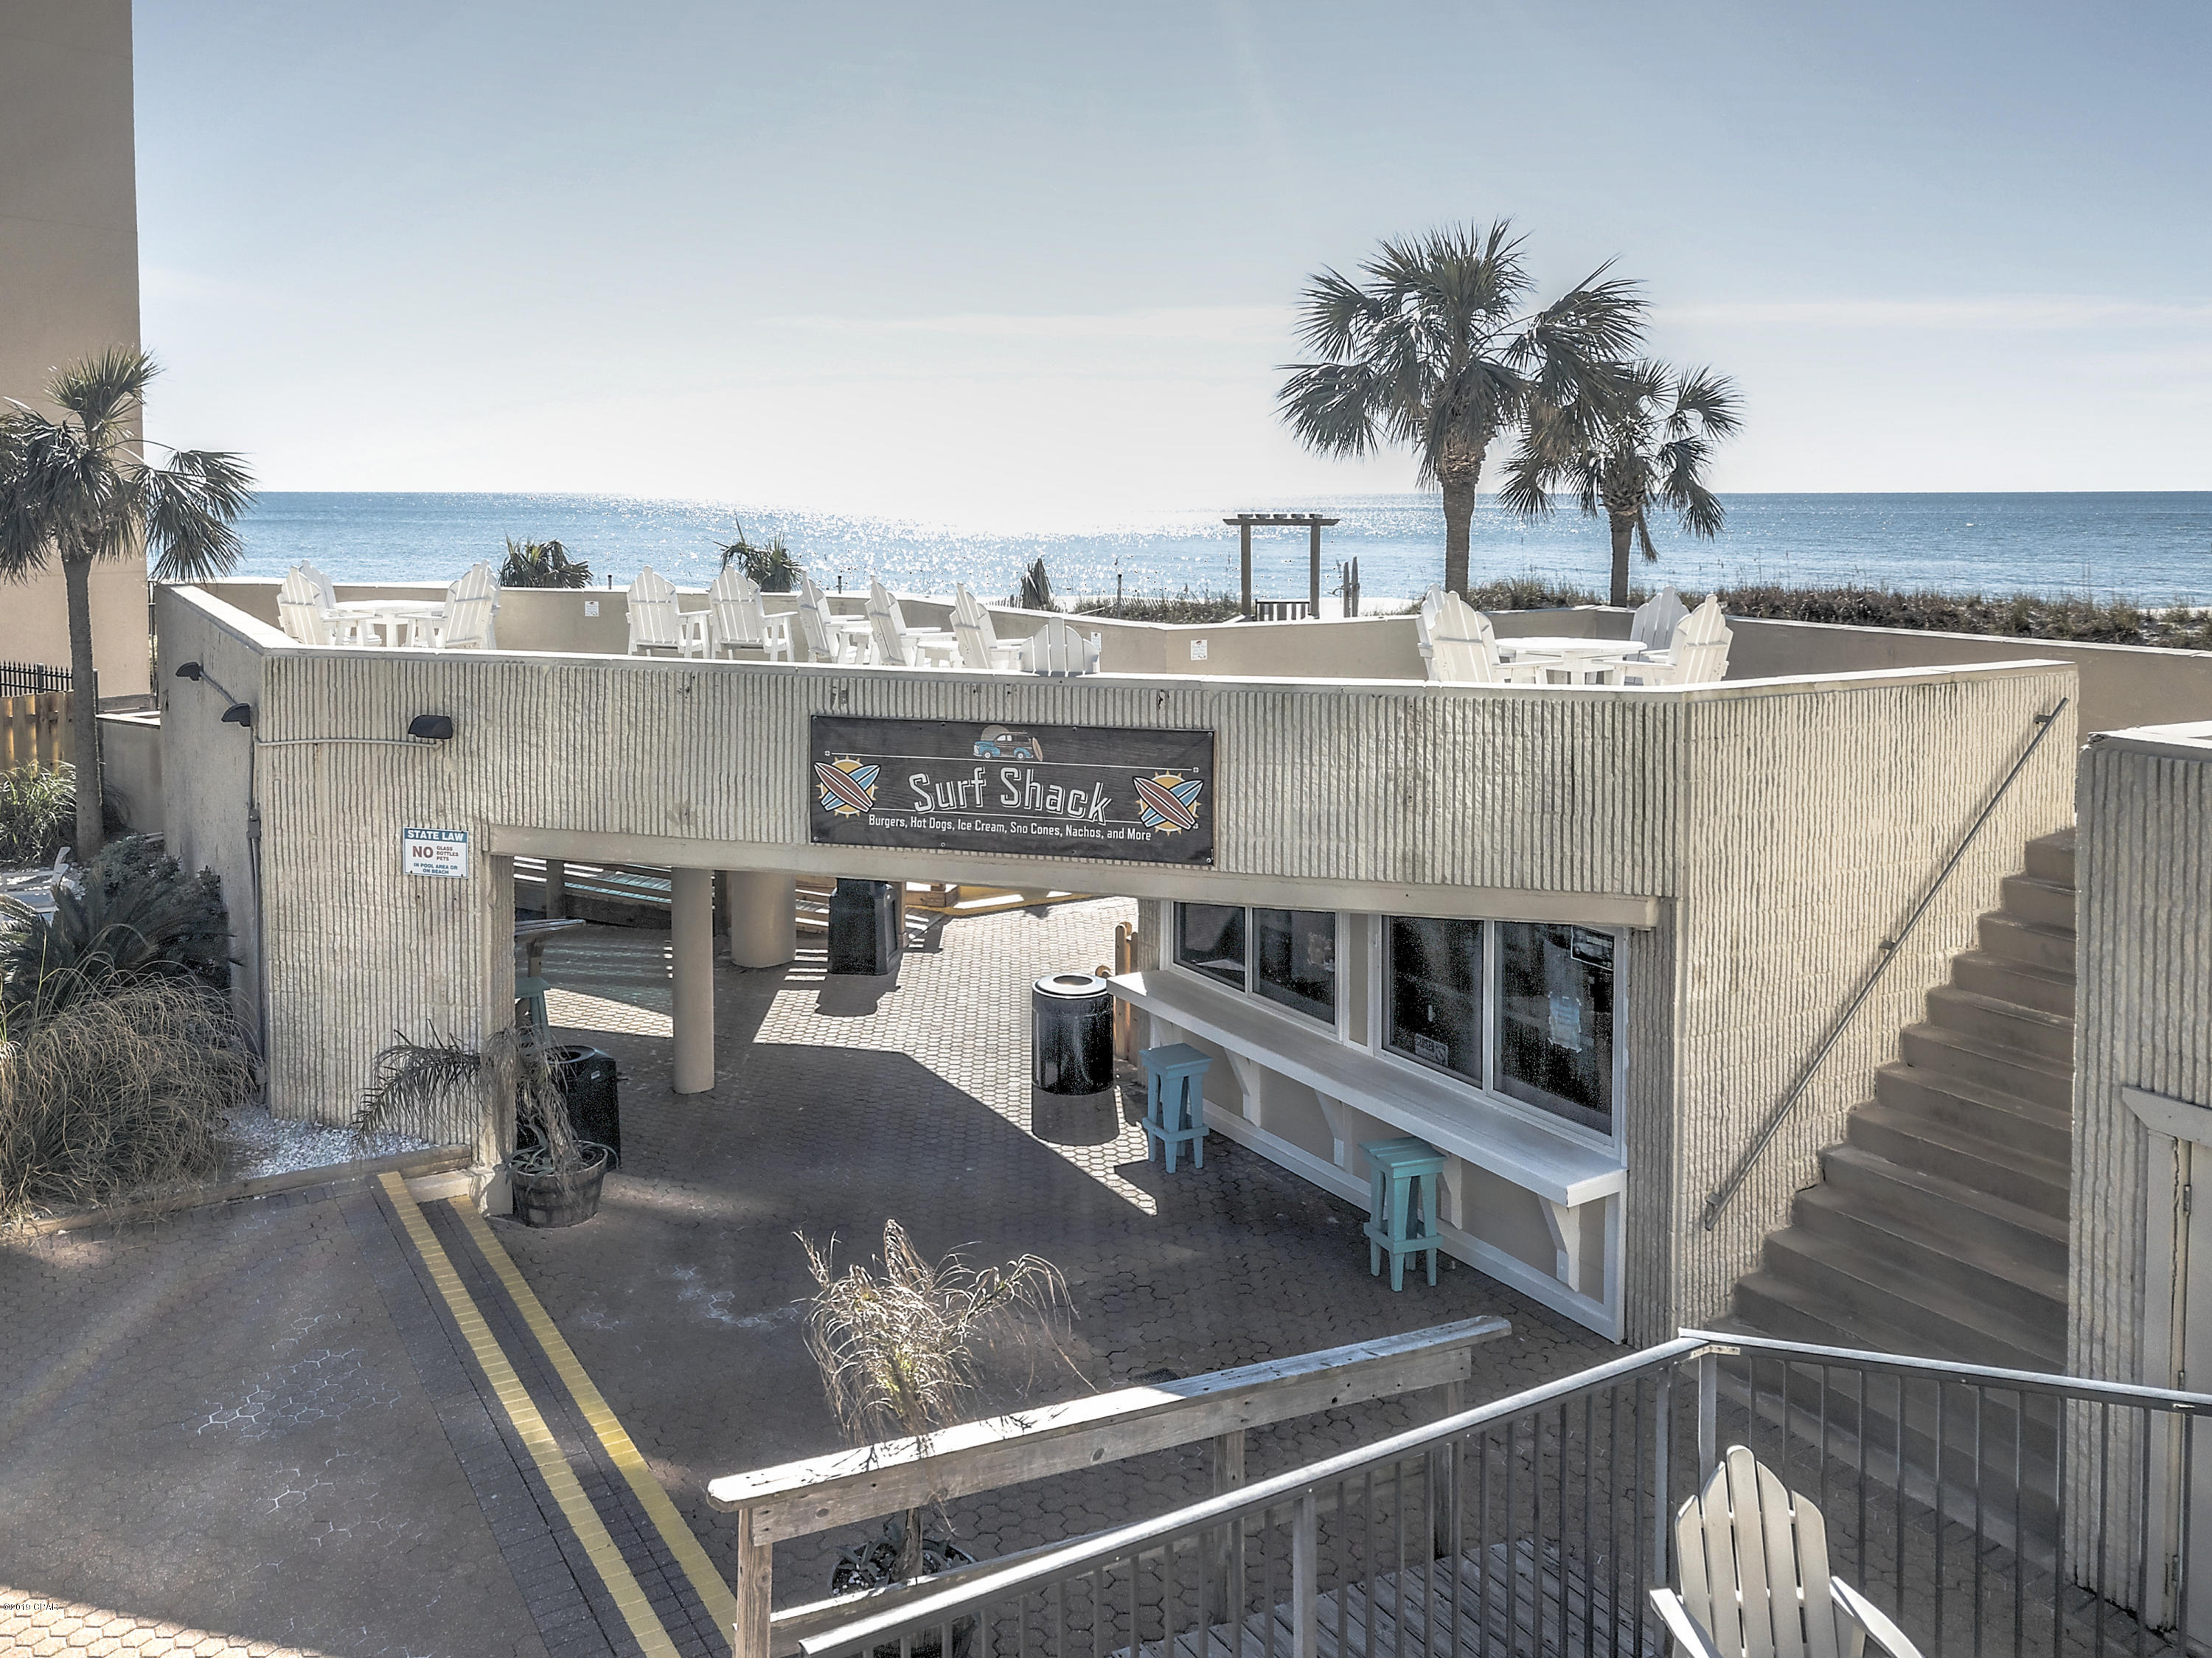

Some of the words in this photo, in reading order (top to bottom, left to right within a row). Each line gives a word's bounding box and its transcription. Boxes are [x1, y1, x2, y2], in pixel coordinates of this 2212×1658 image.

[909, 766, 987, 815] Surf
[1000, 767, 1112, 826] Shack
[407, 830, 439, 840] STATE
[442, 832, 464, 841] LAW
[869, 814, 908, 828] Burgers,
[911, 816, 927, 829] Hot
[929, 817, 955, 831] Dogs,
[958, 818, 972, 831] Ice
[975, 820, 1007, 833] Cream,
[1010, 821, 1028, 834] Sno
[1031, 823, 1062, 837] Cones,
[1065, 824, 1104, 839] Nachos,
[1107, 827, 1124, 840] and
[1127, 828, 1152, 841] More
[412, 845, 434, 858] NO
